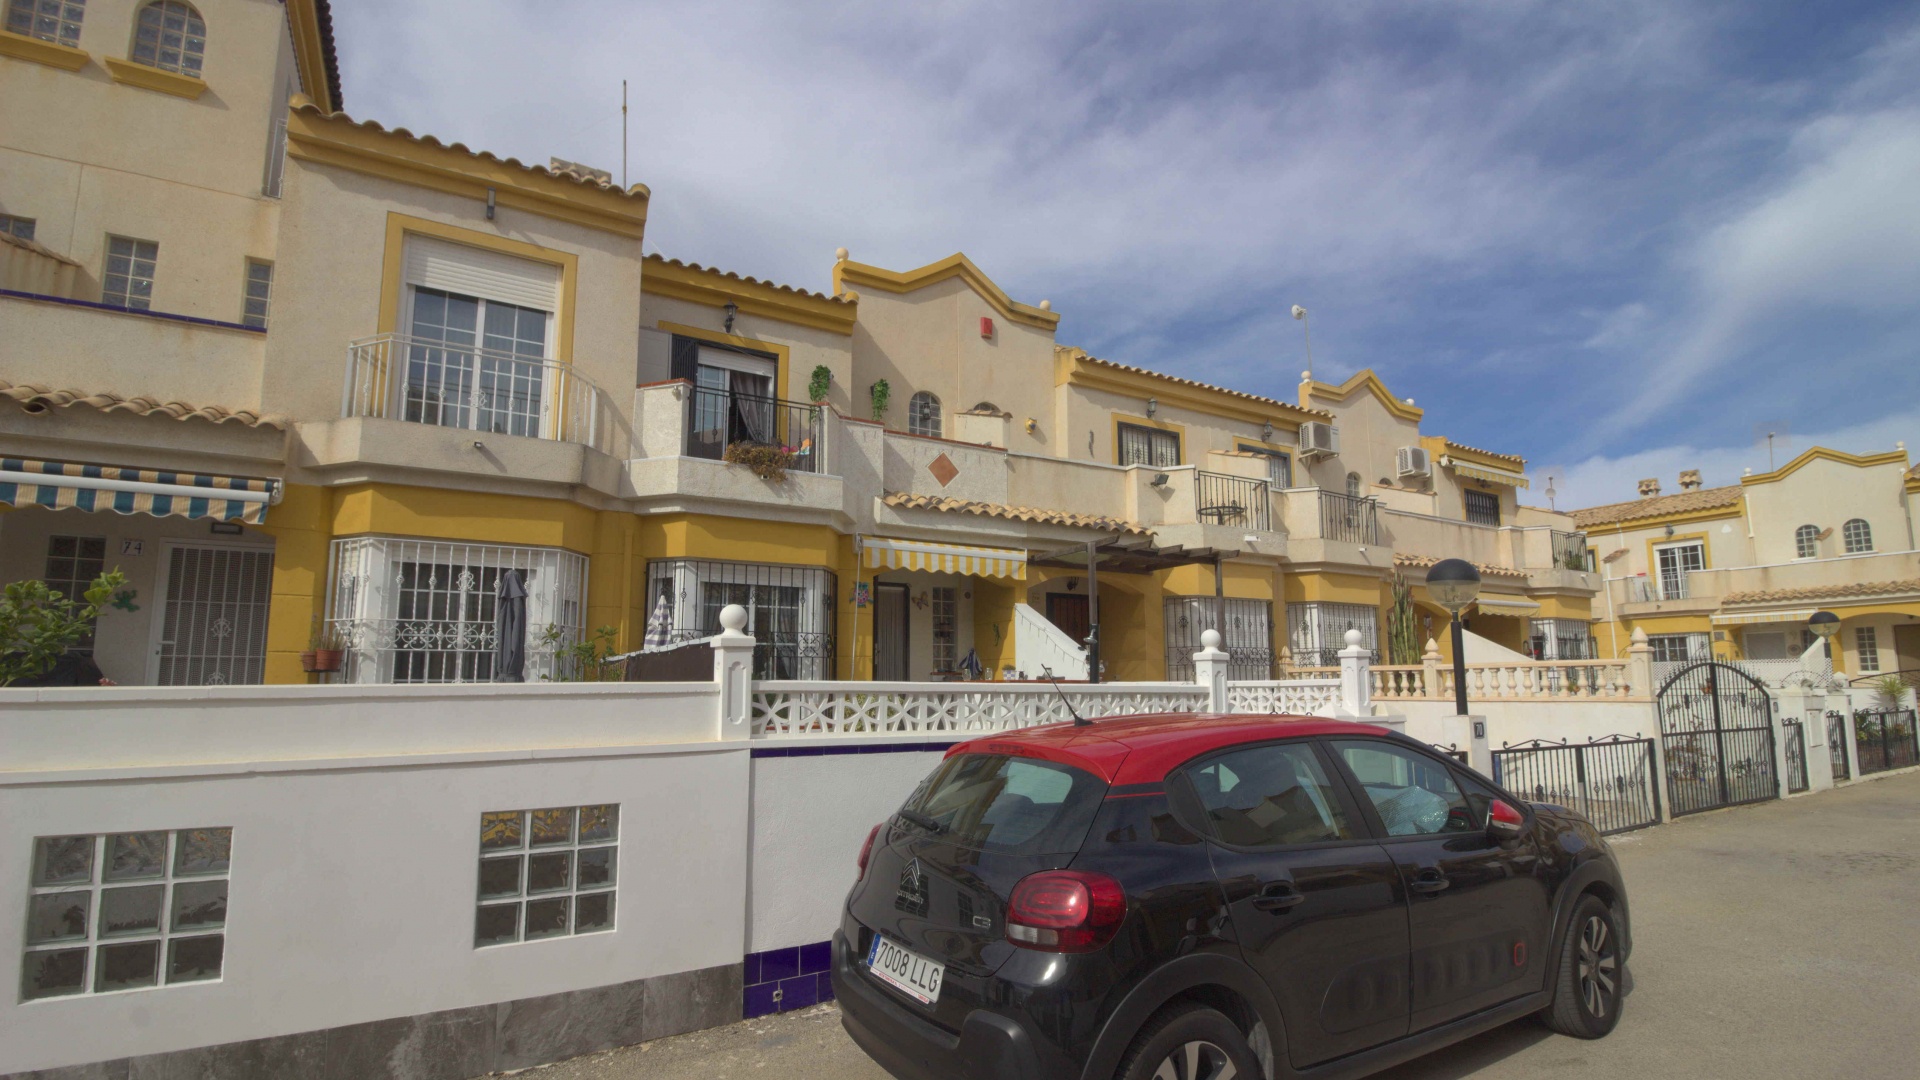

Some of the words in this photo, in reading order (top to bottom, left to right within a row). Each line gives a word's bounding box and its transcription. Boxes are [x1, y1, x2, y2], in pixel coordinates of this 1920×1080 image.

[123, 541, 142, 555] 74
[972, 915, 991, 930] C3
[877, 941, 910, 977] 7008
[910, 958, 940, 993] LLG
